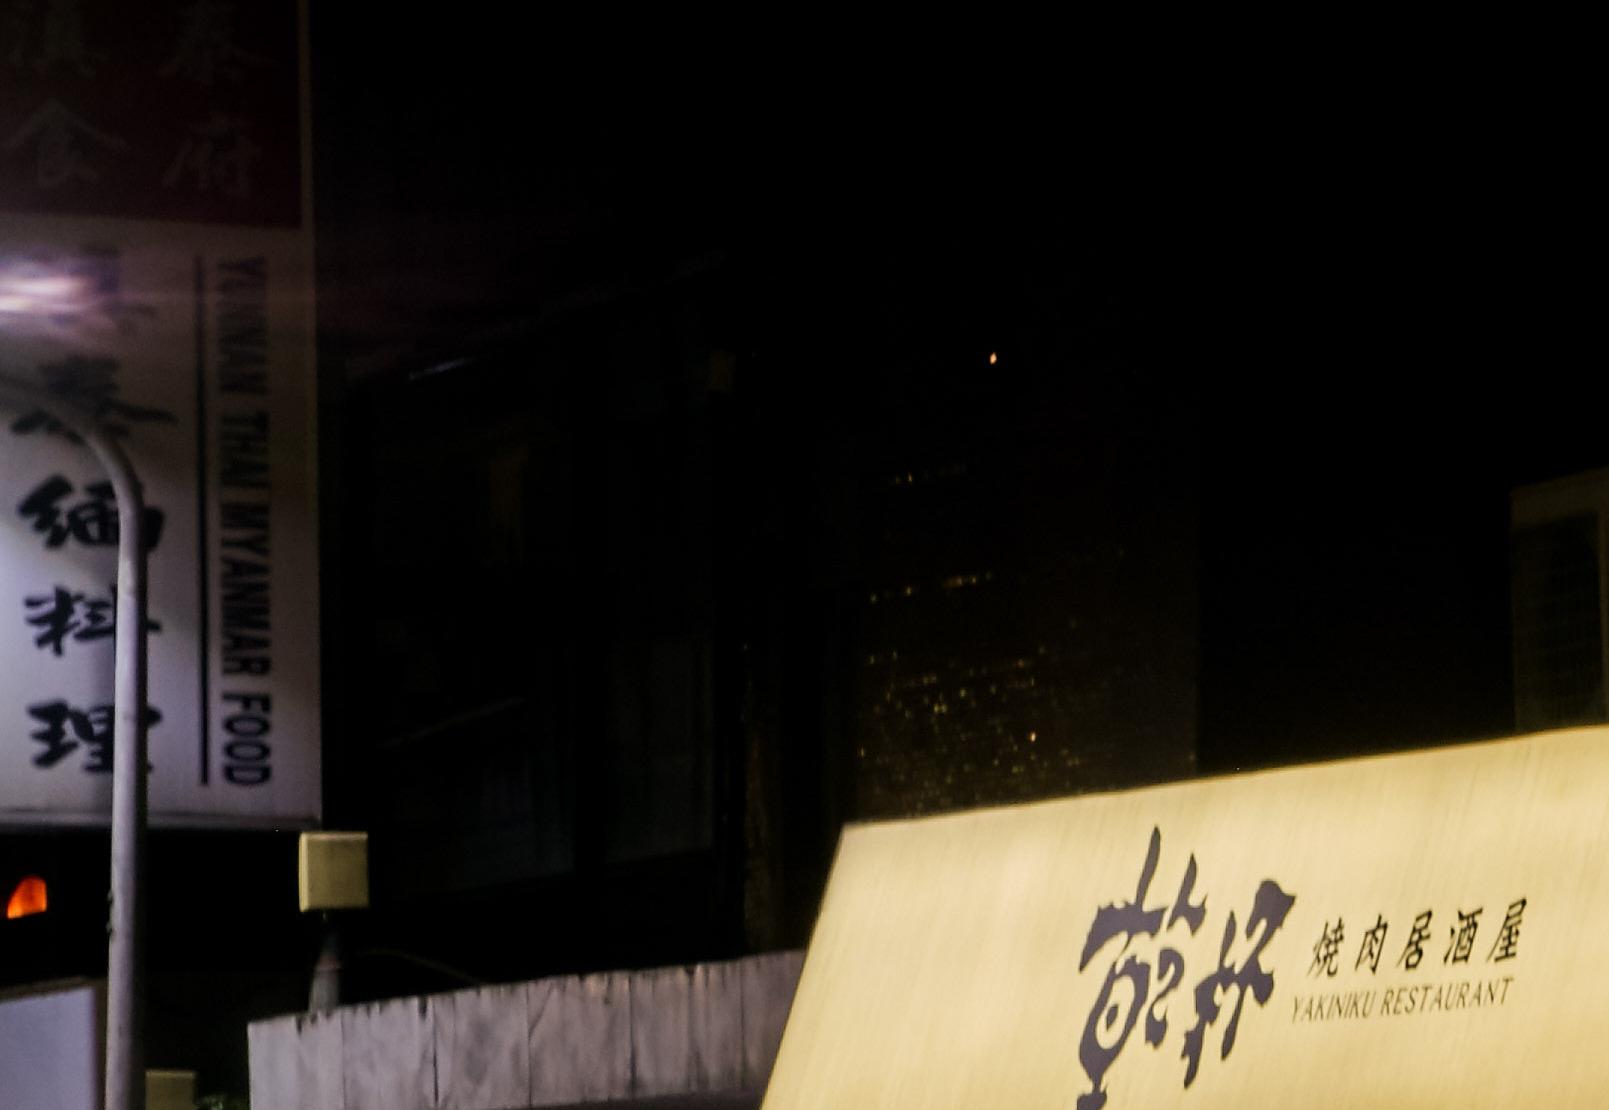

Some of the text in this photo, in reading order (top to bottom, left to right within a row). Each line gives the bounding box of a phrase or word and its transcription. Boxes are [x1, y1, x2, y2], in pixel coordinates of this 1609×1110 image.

[217, 257, 274, 788] YUNNAN THAI MYANMAR FOOD
[1291, 977, 1516, 1024] YAKINIKU RESTAURANT
